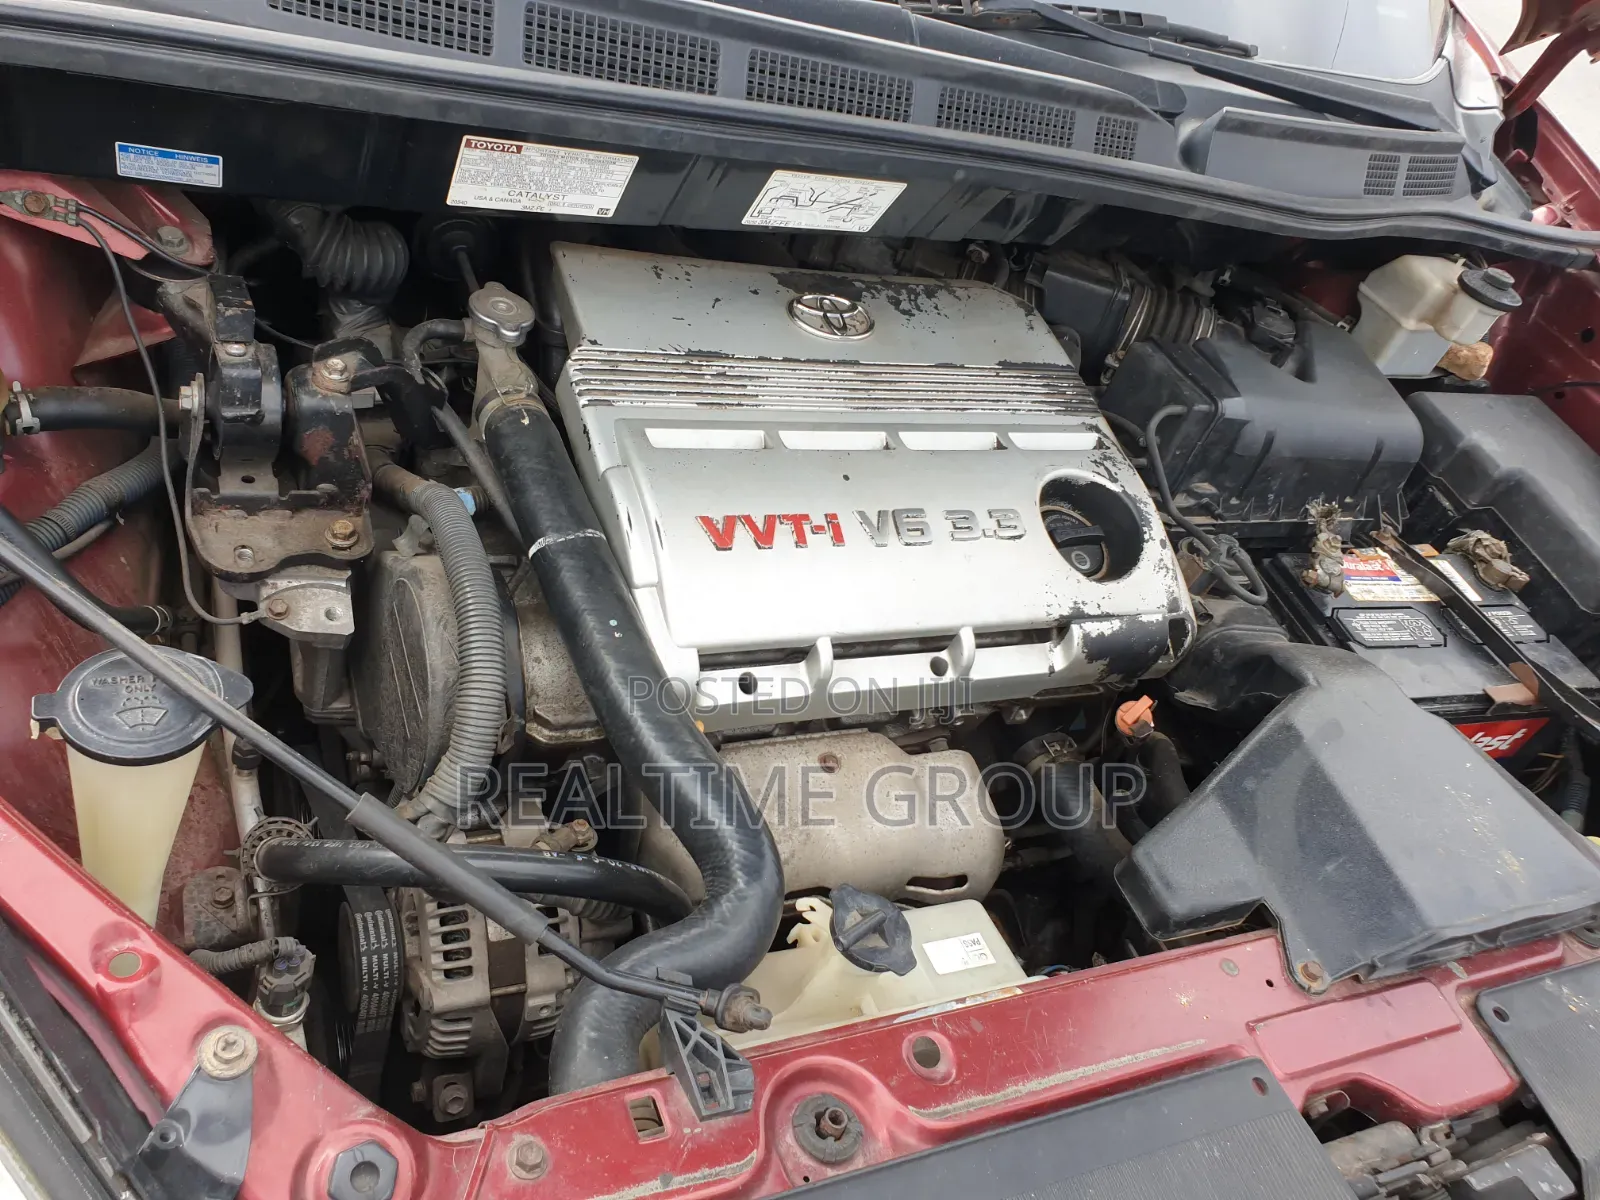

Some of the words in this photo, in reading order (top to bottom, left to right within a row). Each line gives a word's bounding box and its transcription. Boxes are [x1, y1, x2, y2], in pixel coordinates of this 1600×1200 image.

[470, 140, 518, 153] TOYOTA
[128, 147, 159, 157] NOTICE
[175, 153, 209, 163] HINWEIS
[507, 190, 568, 201] CATALYST
[694, 512, 845, 551] VVT-i
[852, 508, 933, 547] V6
[942, 508, 1027, 542] 3.3
[92, 675, 145, 686] WASHER
[125, 684, 157, 693] ONLY
[354, 912, 367, 946] Continental
[364, 911, 377, 943] Continental
[374, 910, 388, 942] Continental
[962, 937, 982, 948] PASS
